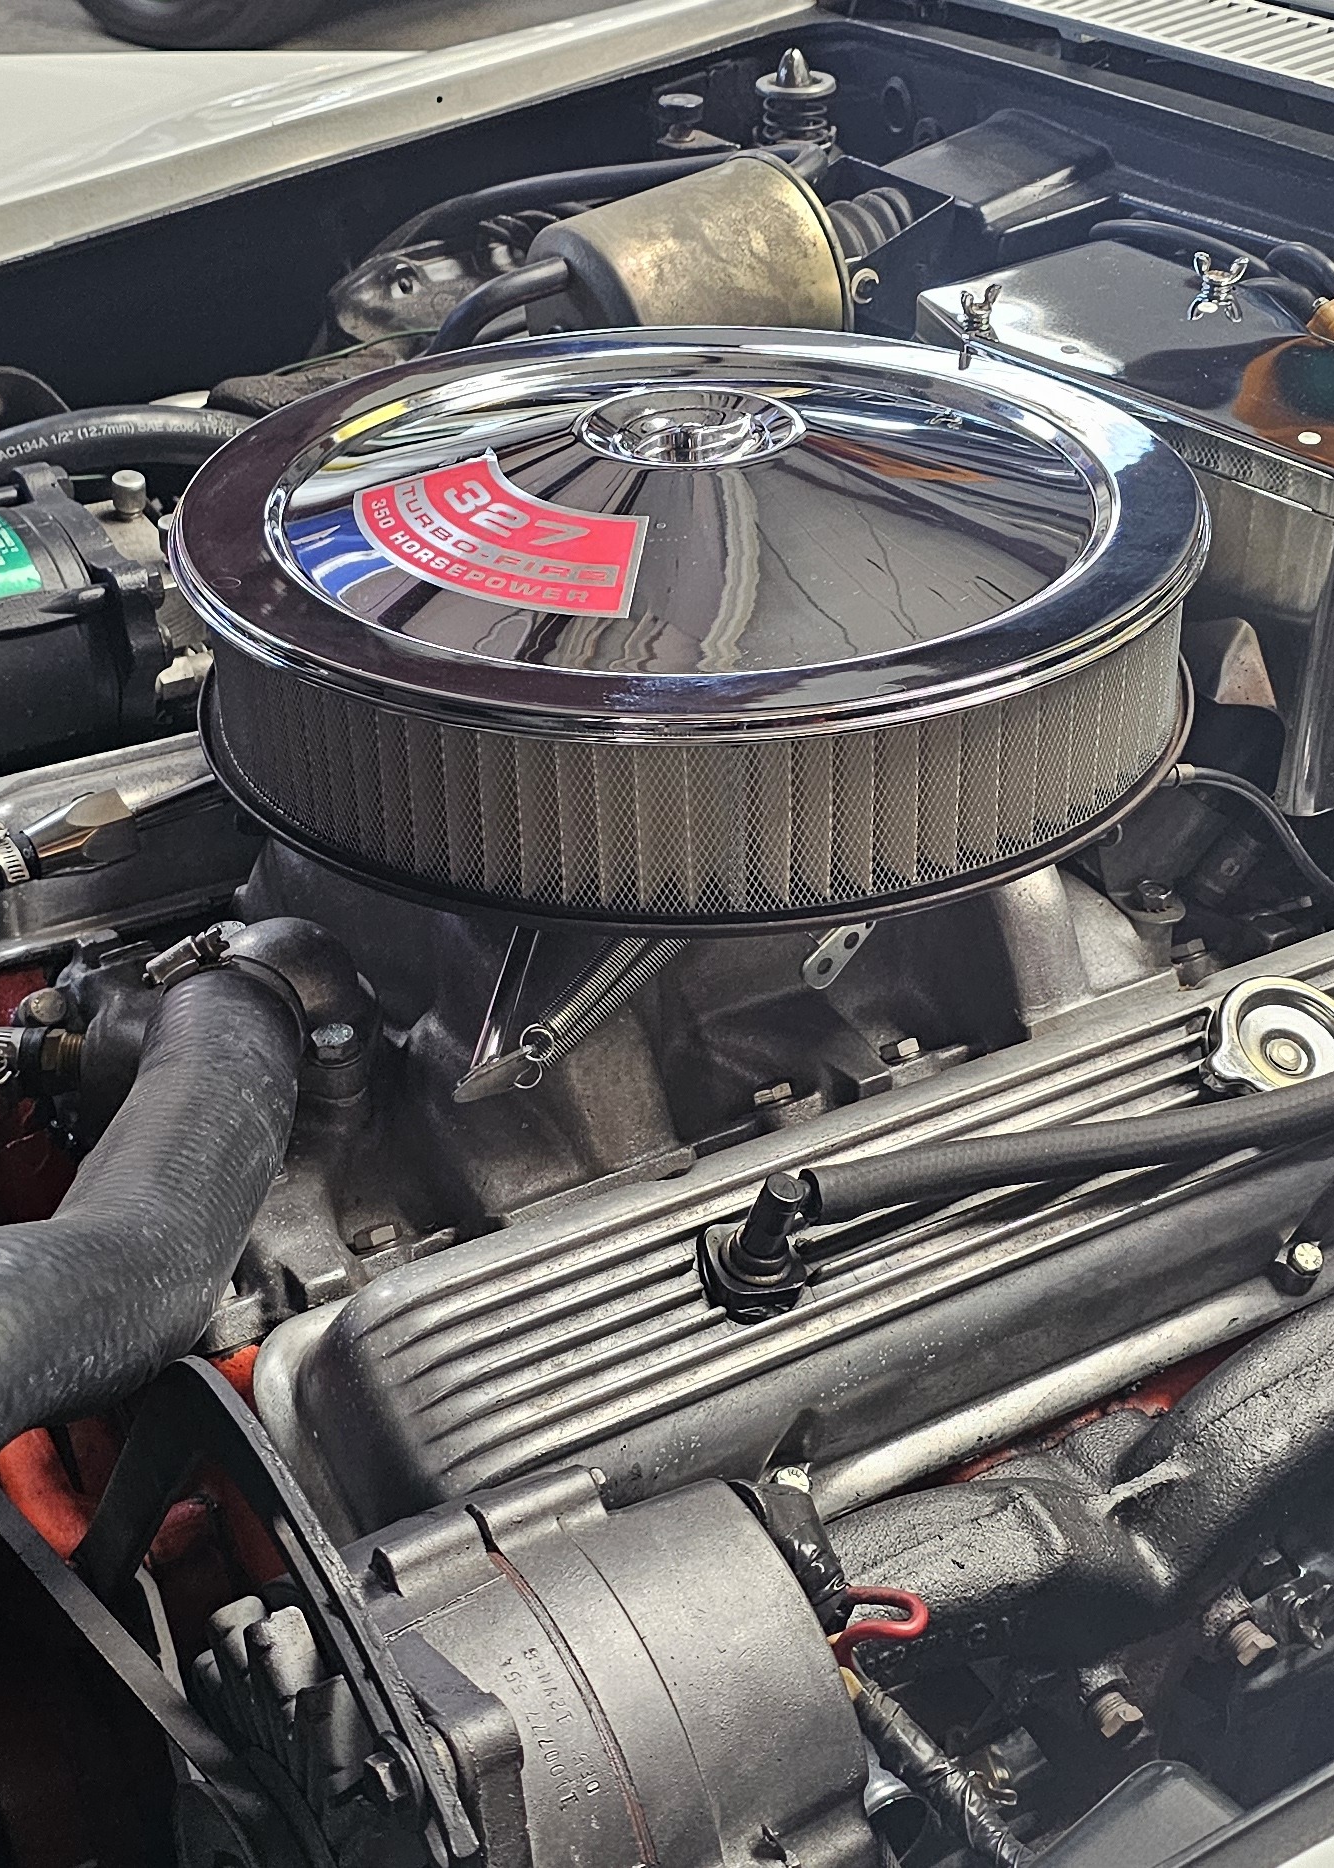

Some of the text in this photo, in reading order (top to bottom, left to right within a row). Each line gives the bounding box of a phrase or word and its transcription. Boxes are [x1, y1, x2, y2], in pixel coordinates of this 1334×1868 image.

[77, 422, 135, 441] (12.7mm)
[371, 498, 589, 603] 350 HORSEPOWER
[402, 485, 608, 581] TURBO-FIRE
[443, 480, 591, 547] 327
